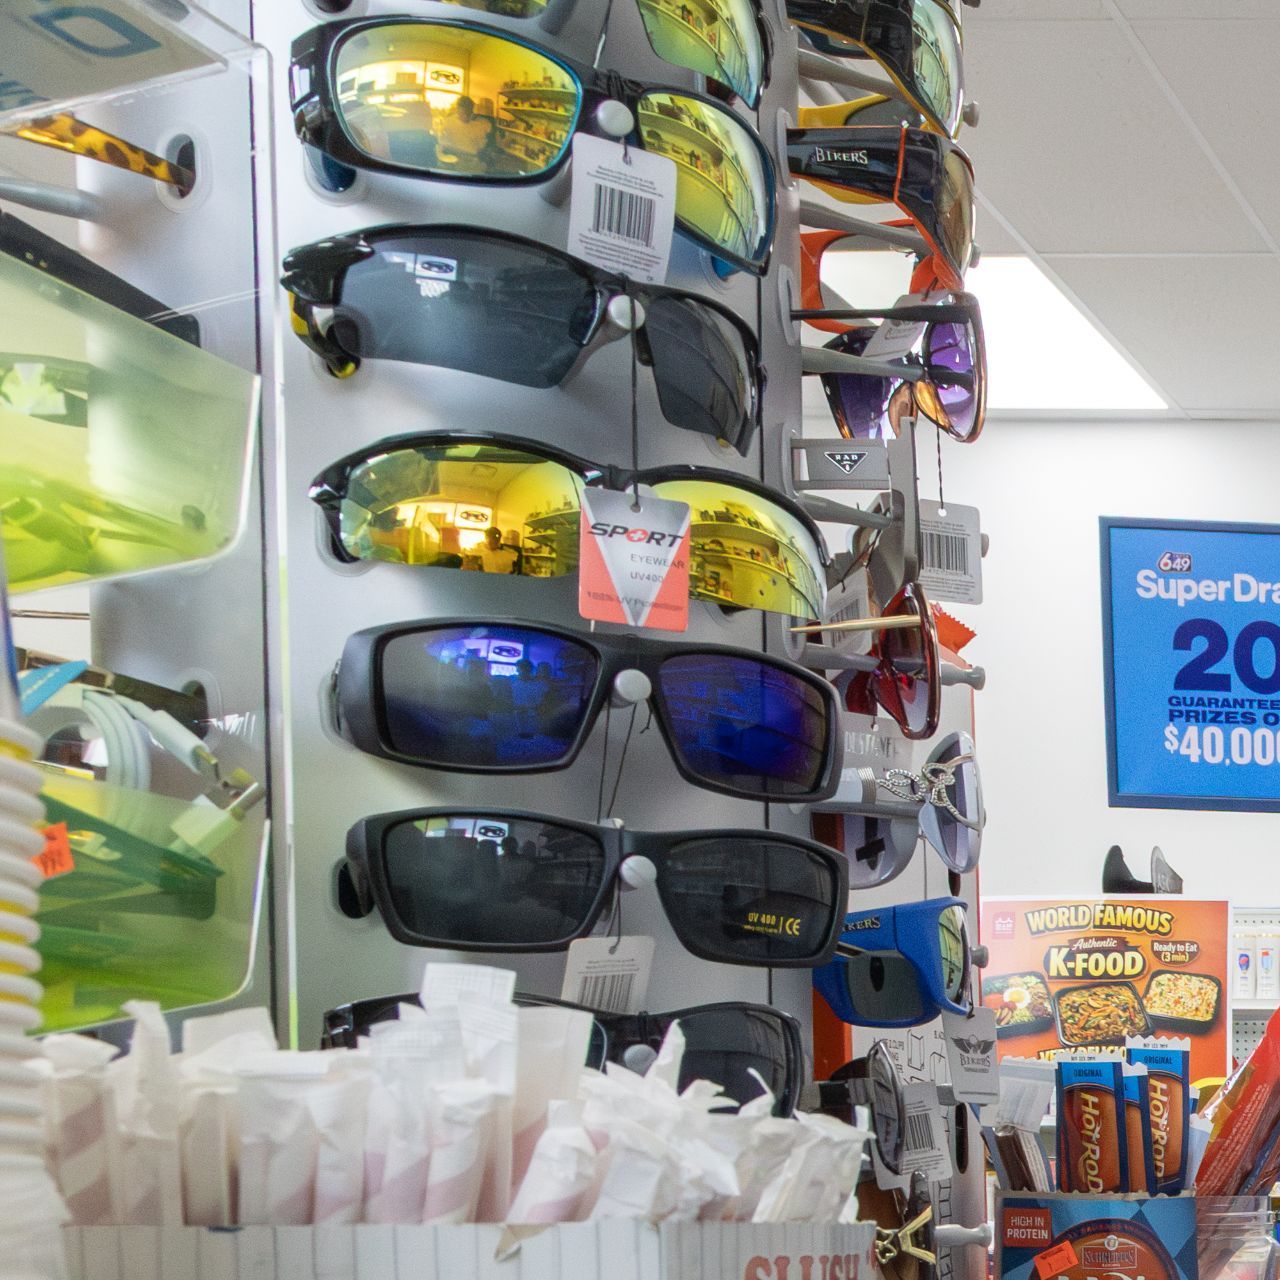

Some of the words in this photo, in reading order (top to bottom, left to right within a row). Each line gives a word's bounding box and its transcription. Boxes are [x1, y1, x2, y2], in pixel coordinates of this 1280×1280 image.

[815, 146, 868, 165] BIKERS
[834, 452, 860, 462] RAD
[587, 522, 684, 548] SPORT
[630, 553, 685, 569] EYEWEAR
[1167, 710, 1258, 725] PRIZES
[843, 917, 881, 931] KERS
[1026, 906, 1091, 933] WORLD
[1094, 905, 1174, 934] FAMOUS
[1072, 938, 1117, 950] Authentic
[1153, 943, 1175, 953] Ready
[1177, 944, 1184, 952] to
[1185, 943, 1197, 952] Eat
[1050, 948, 1143, 977] K-FOOD
[1171, 953, 1189, 962] min)
[1144, 1056, 1172, 1064] ORIGINAL
[1011, 1216, 1032, 1226] HIGH
[1035, 1217, 1044, 1226] IN
[1007, 1228, 1048, 1240] PROTEIN
